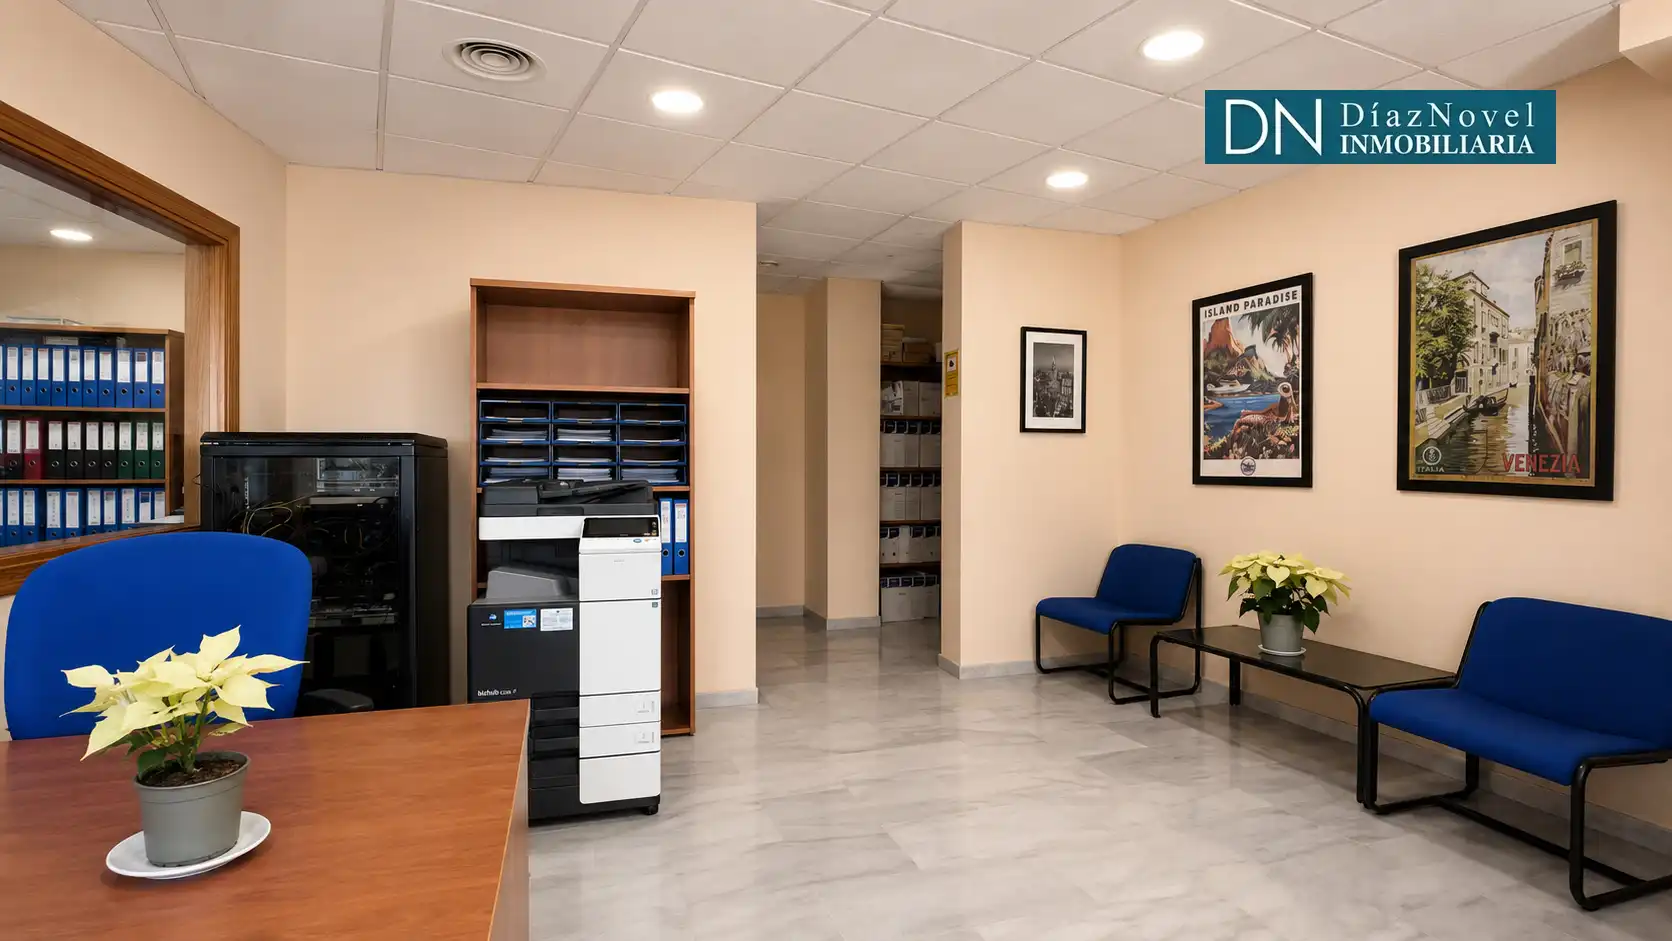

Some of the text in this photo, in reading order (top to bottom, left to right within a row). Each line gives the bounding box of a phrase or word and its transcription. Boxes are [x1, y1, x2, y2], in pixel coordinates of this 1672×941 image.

[1204, 290, 1298, 318] ISLAND PARADISE
[1502, 453, 1581, 473] VENEZIA
